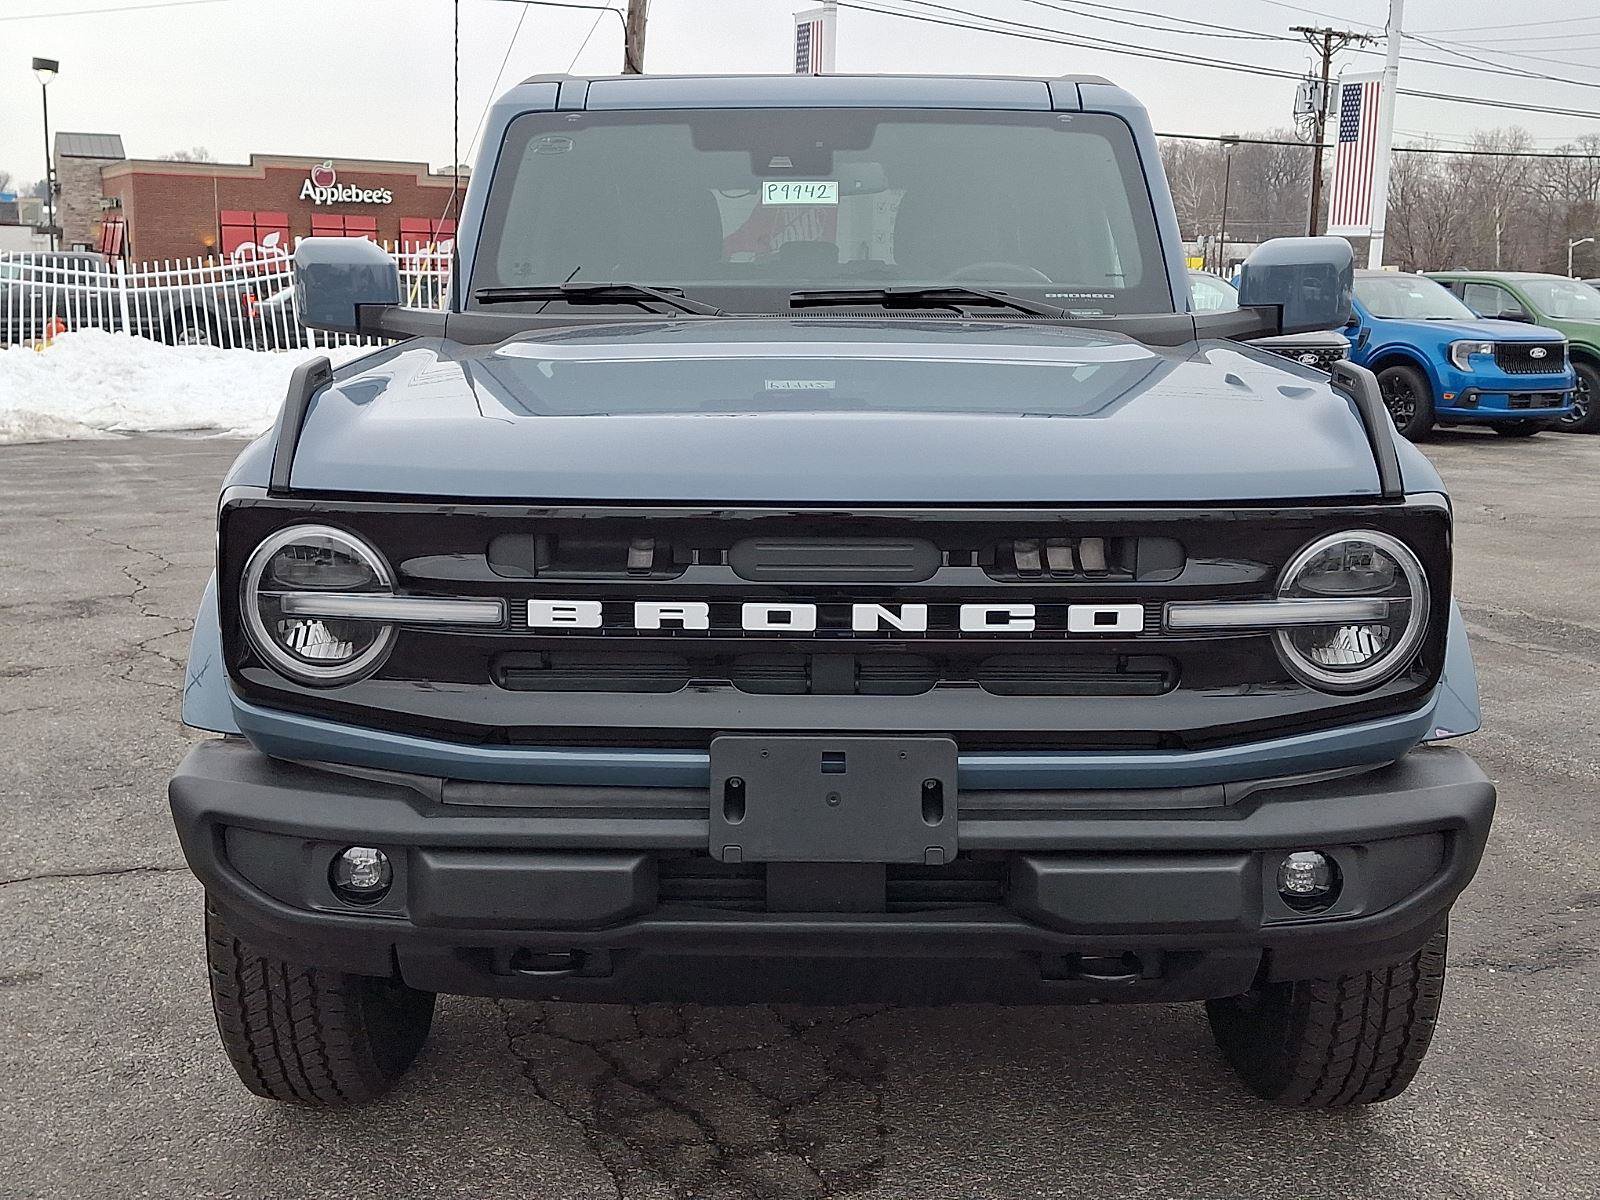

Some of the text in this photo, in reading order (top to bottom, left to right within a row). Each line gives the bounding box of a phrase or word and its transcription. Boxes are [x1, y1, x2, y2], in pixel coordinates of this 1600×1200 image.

[299, 178, 393, 205] Applebee's
[768, 184, 831, 200] P9942
[527, 599, 1144, 632] BRONCO
